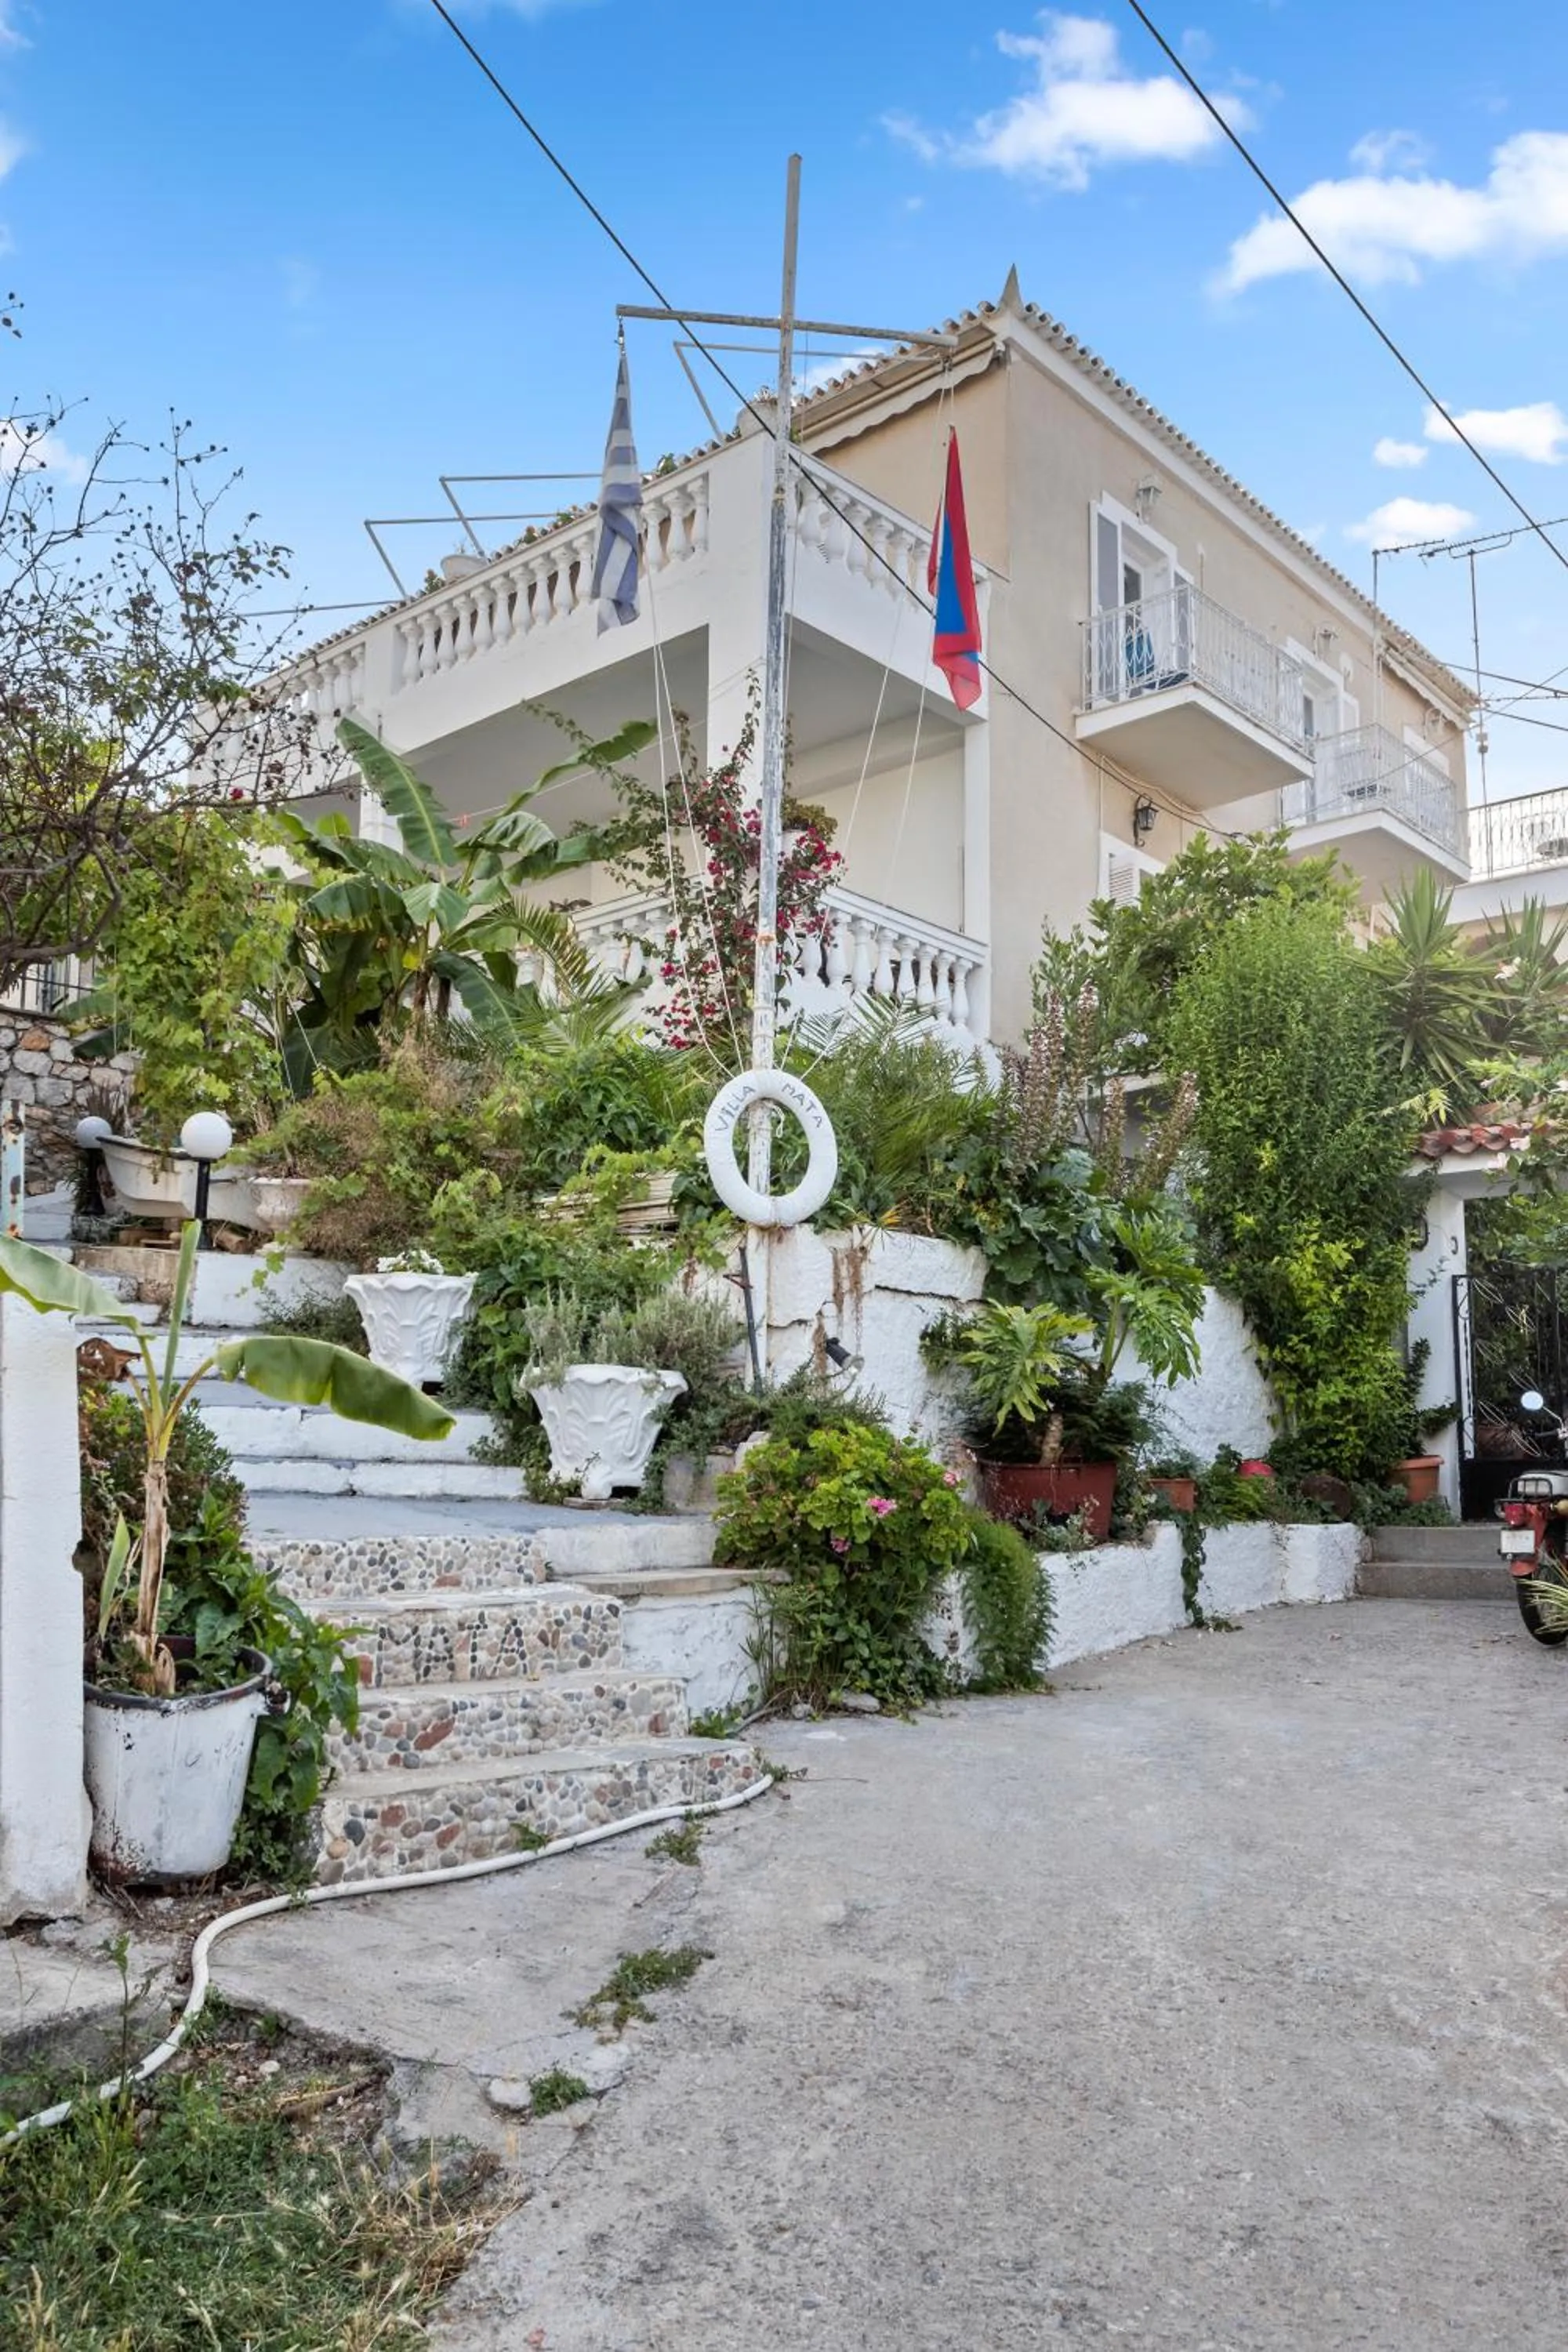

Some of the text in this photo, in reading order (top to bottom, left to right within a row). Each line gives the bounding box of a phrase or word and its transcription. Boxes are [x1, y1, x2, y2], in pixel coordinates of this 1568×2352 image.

[715, 1083, 822, 1131] VILLA MATA
[374, 1613, 528, 1686] MATA
